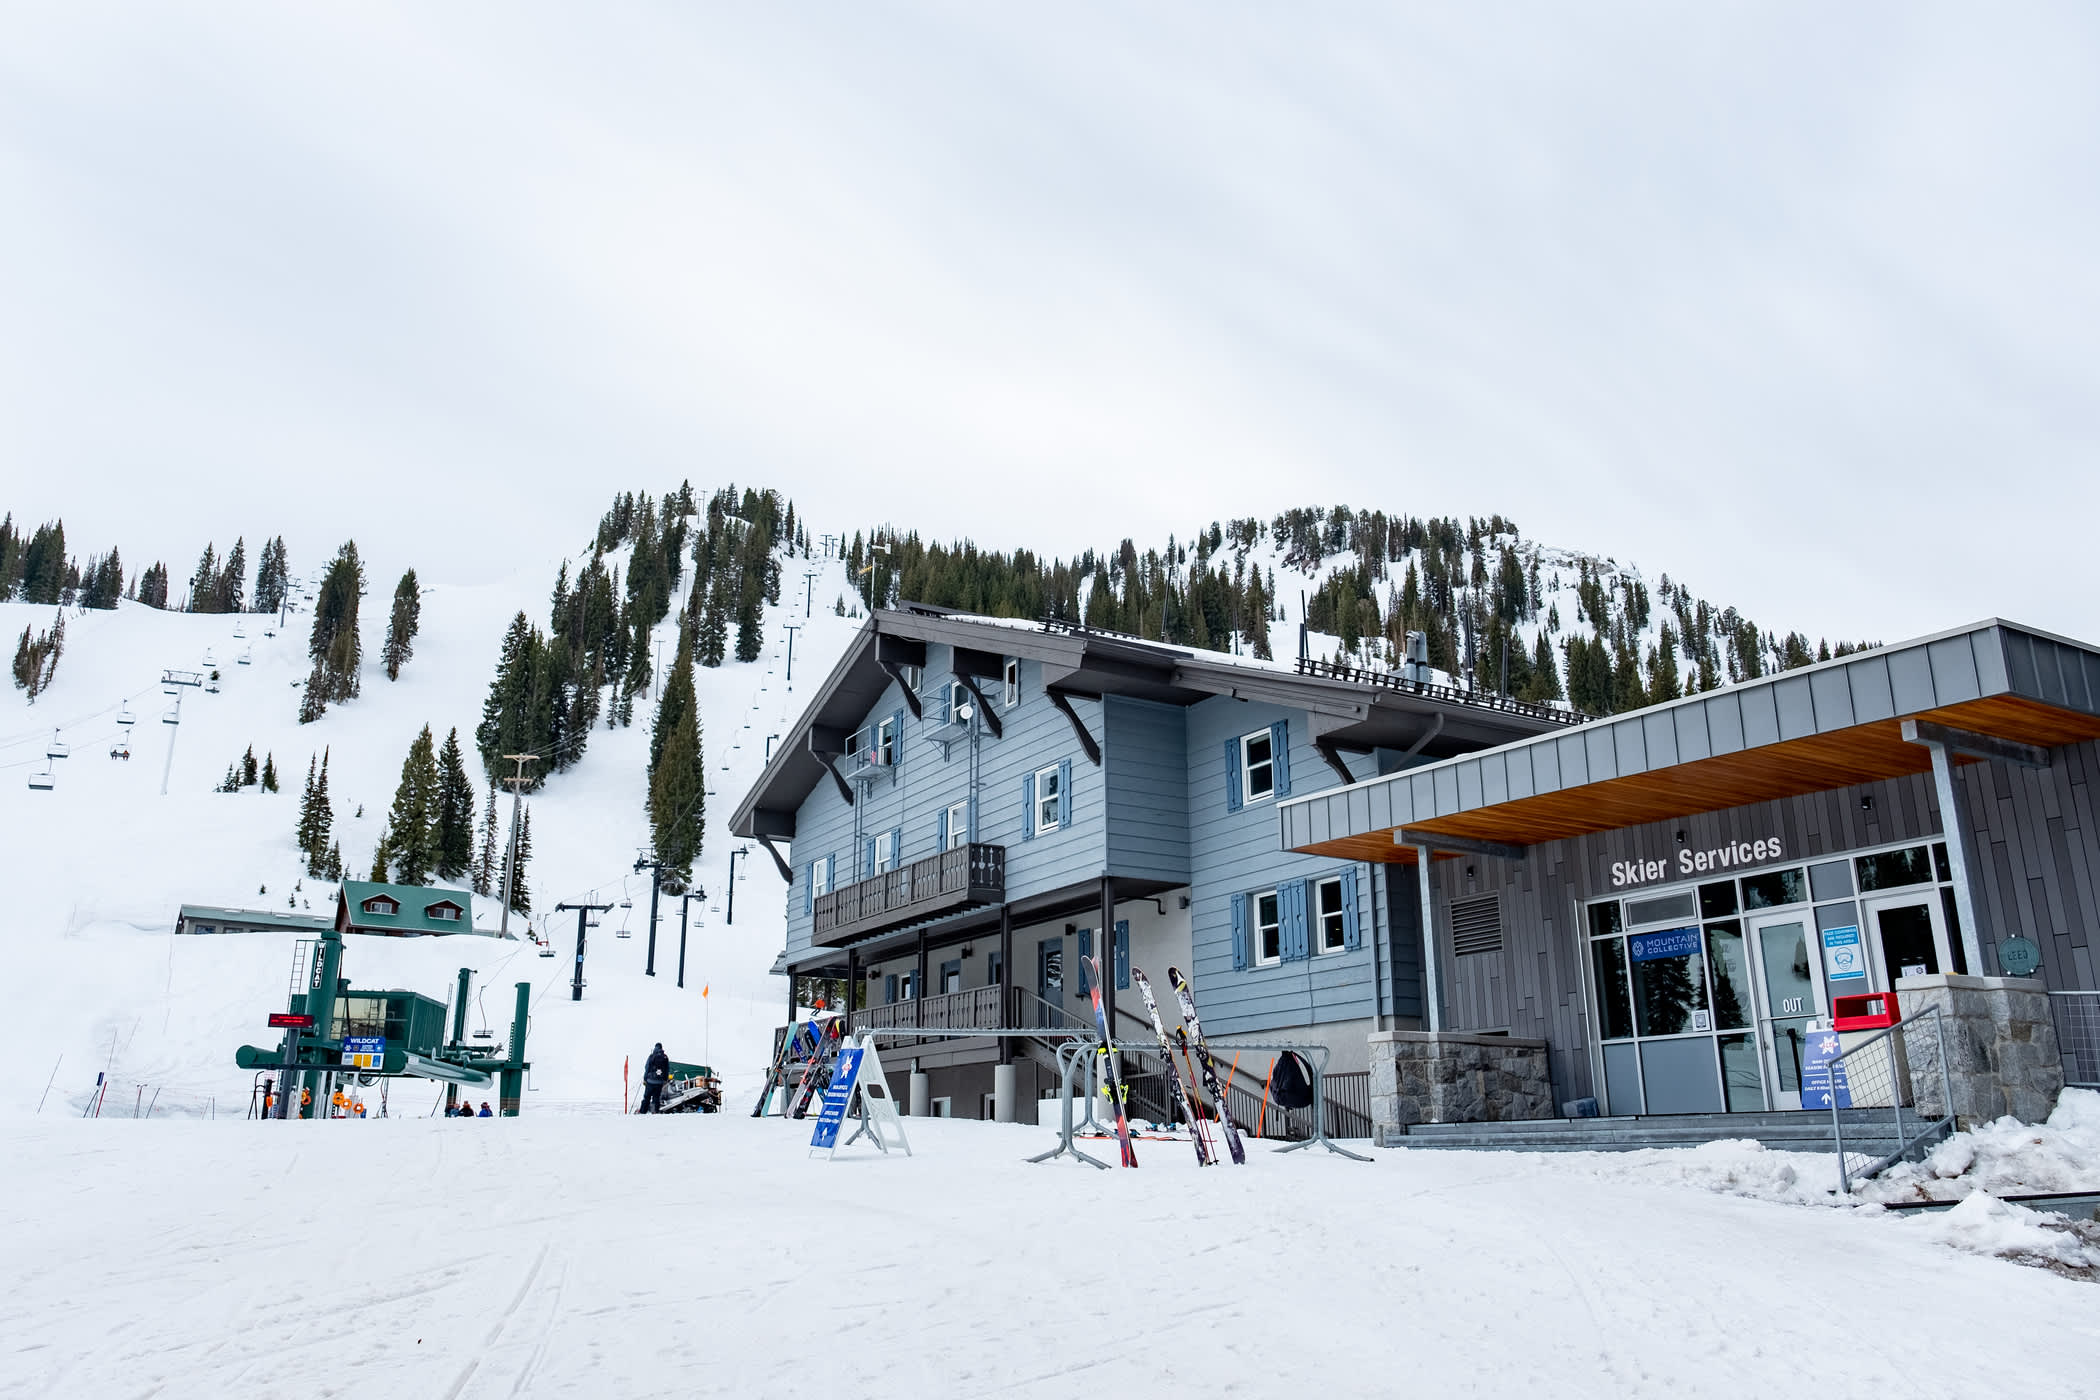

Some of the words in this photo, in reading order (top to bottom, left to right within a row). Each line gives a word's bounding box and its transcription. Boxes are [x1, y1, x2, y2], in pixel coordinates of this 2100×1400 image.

[1612, 858, 1667, 886] Skier
[1679, 837, 1782, 874] Services
[1646, 934, 1697, 948] MOUNTAIN
[1647, 941, 1698, 954] COLLECTIVE
[2008, 950, 2028, 961] LEED
[314, 942, 326, 987] WILDCAT
[1783, 997, 1802, 1013] OUT
